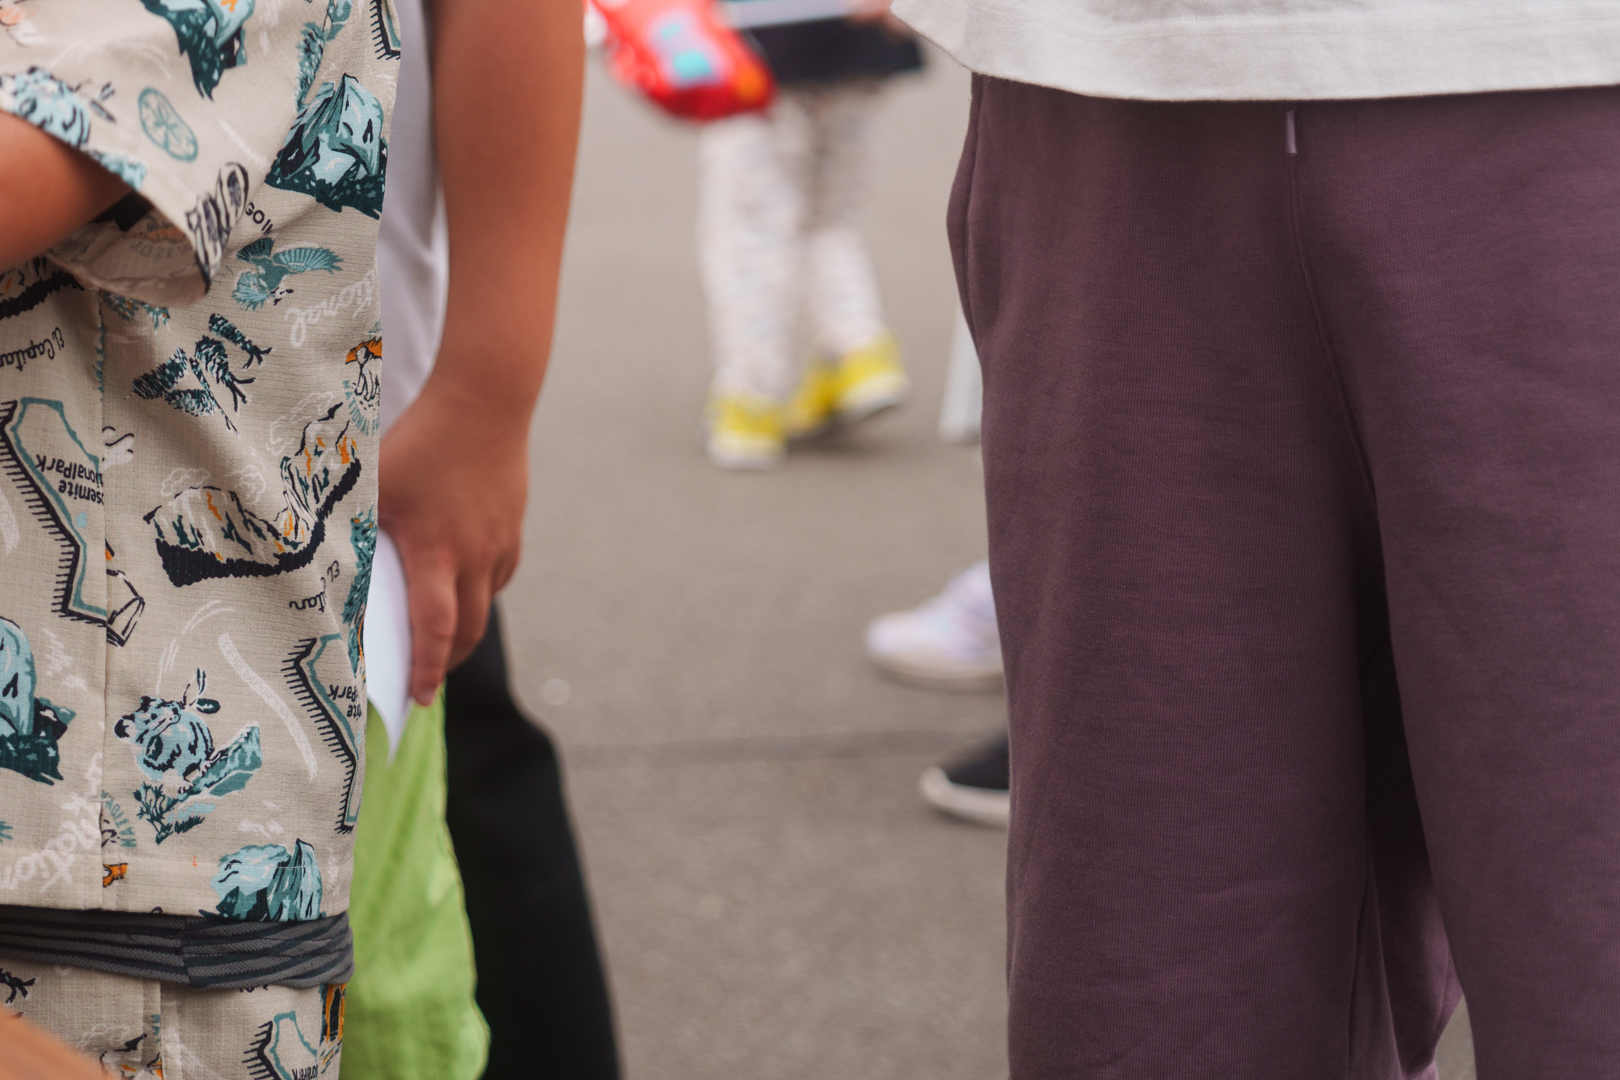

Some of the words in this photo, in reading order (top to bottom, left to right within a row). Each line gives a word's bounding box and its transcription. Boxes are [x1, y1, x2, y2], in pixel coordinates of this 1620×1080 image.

[285, 270, 377, 347] tional
[51, 327, 65, 351] El
[59, 479, 104, 506] semite
